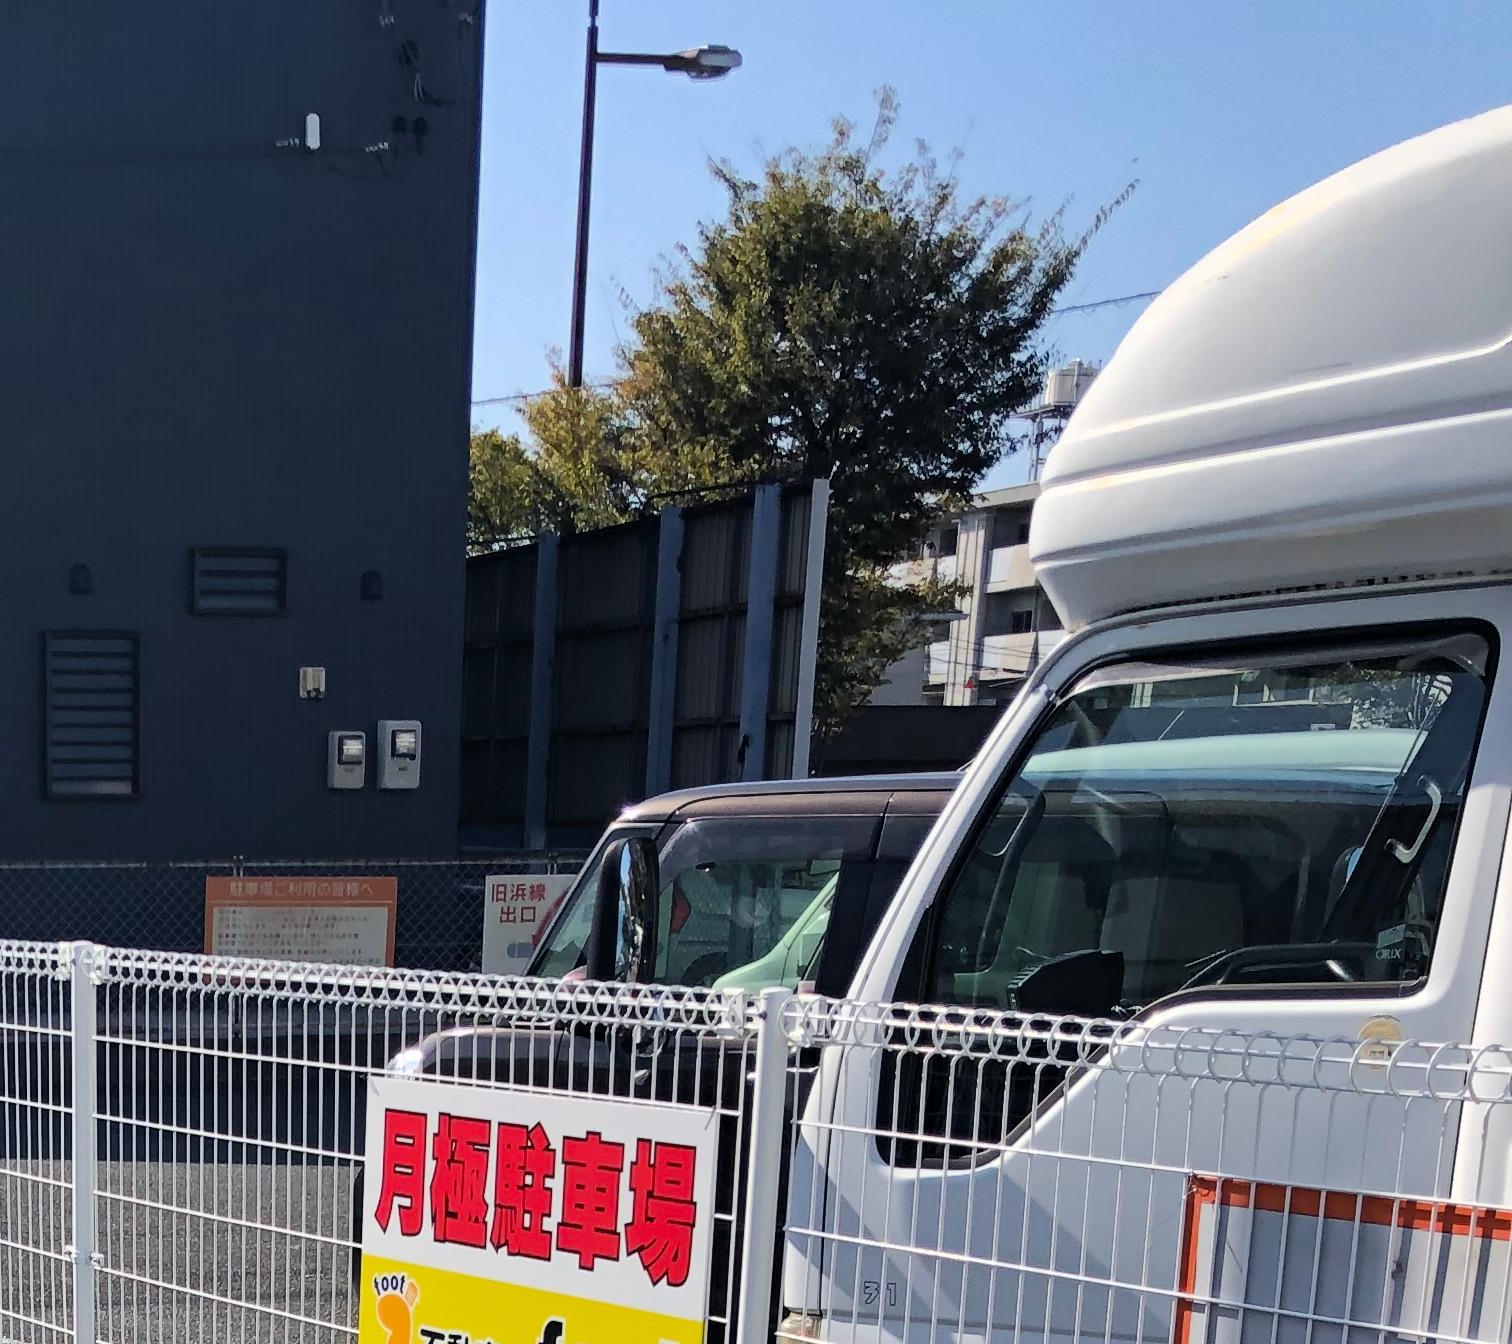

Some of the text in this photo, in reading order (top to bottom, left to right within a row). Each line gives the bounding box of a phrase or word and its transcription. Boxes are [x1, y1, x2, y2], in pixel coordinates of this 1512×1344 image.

[491, 883, 546, 903] 旧浜線
[499, 905, 537, 924] 出口
[375, 1109, 696, 1286] 月極駐車場
